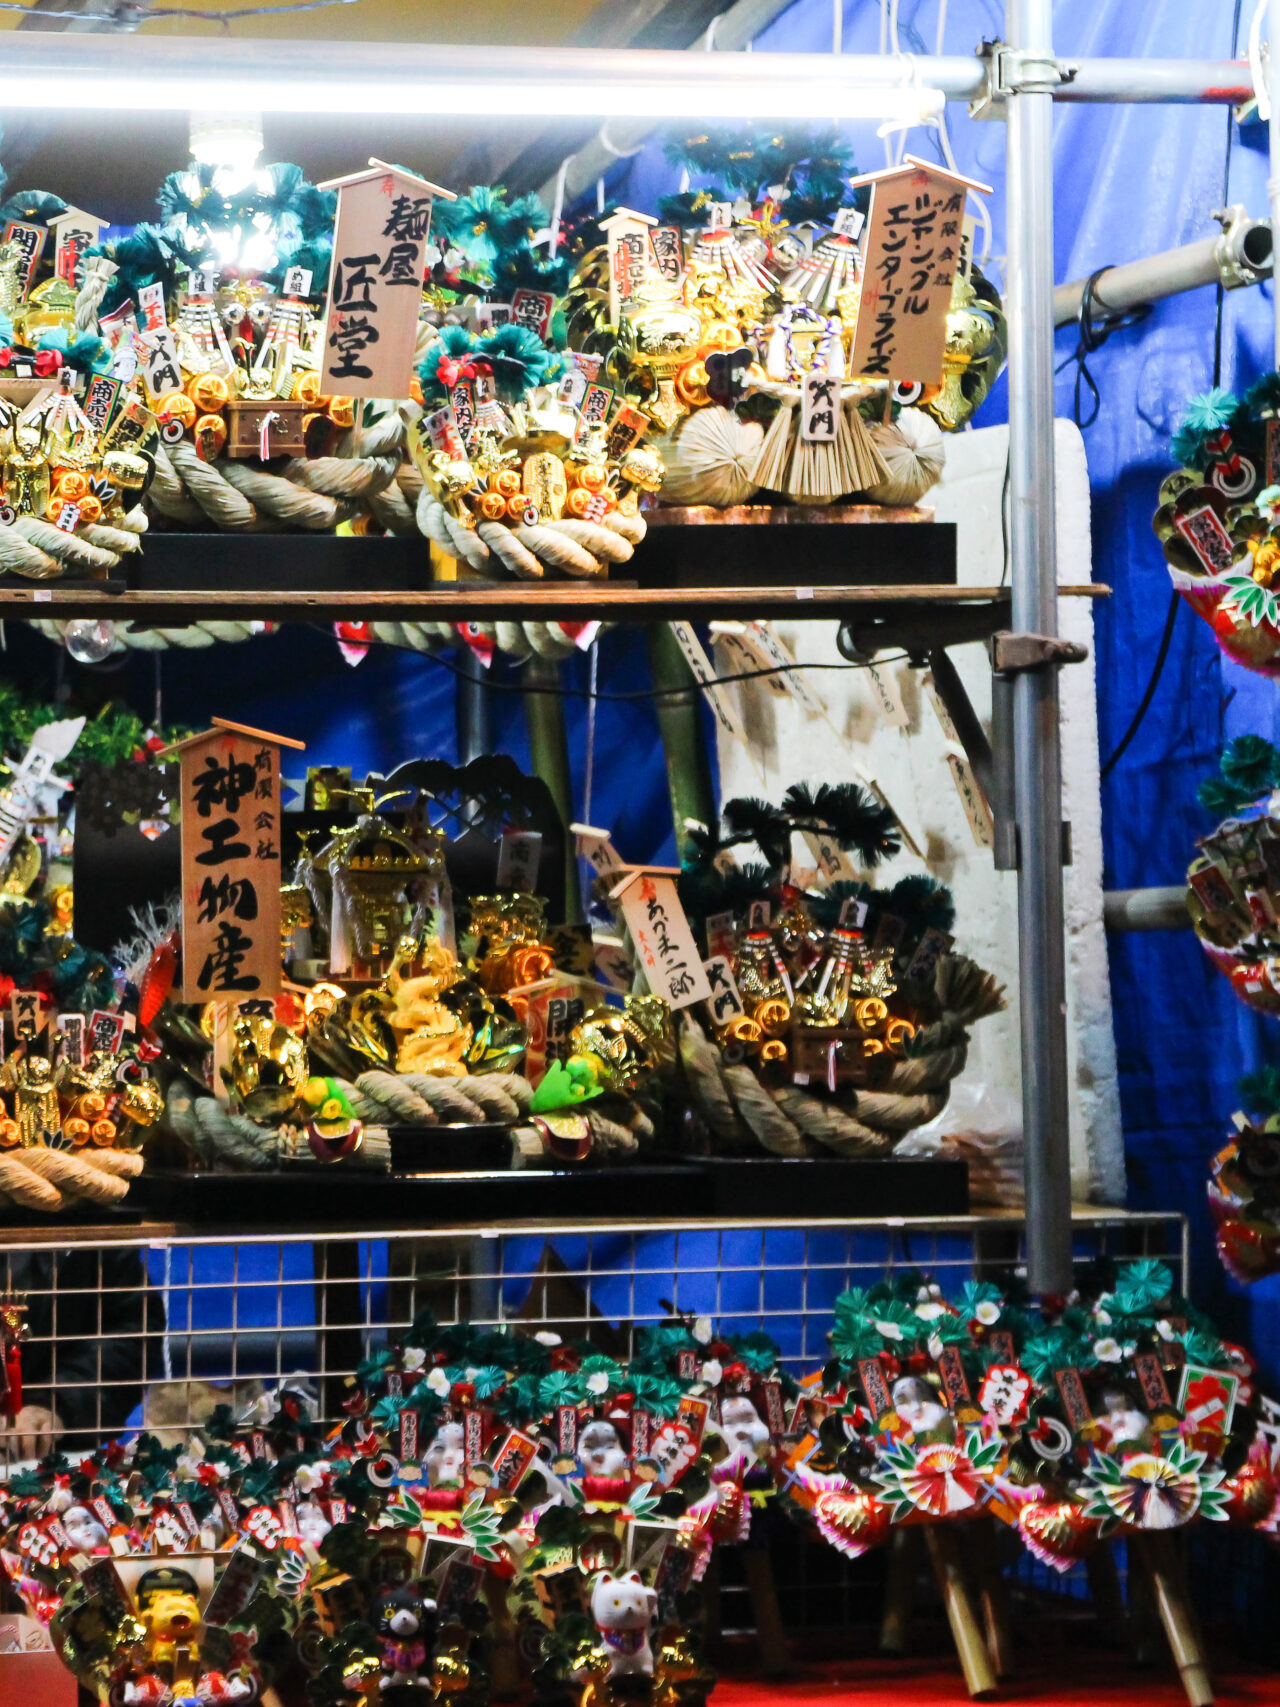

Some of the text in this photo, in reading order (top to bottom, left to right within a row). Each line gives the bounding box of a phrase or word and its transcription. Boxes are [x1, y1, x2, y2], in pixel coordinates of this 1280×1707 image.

[329, 253, 381, 379] 匠堂
[192, 753, 261, 992] 神工物産
